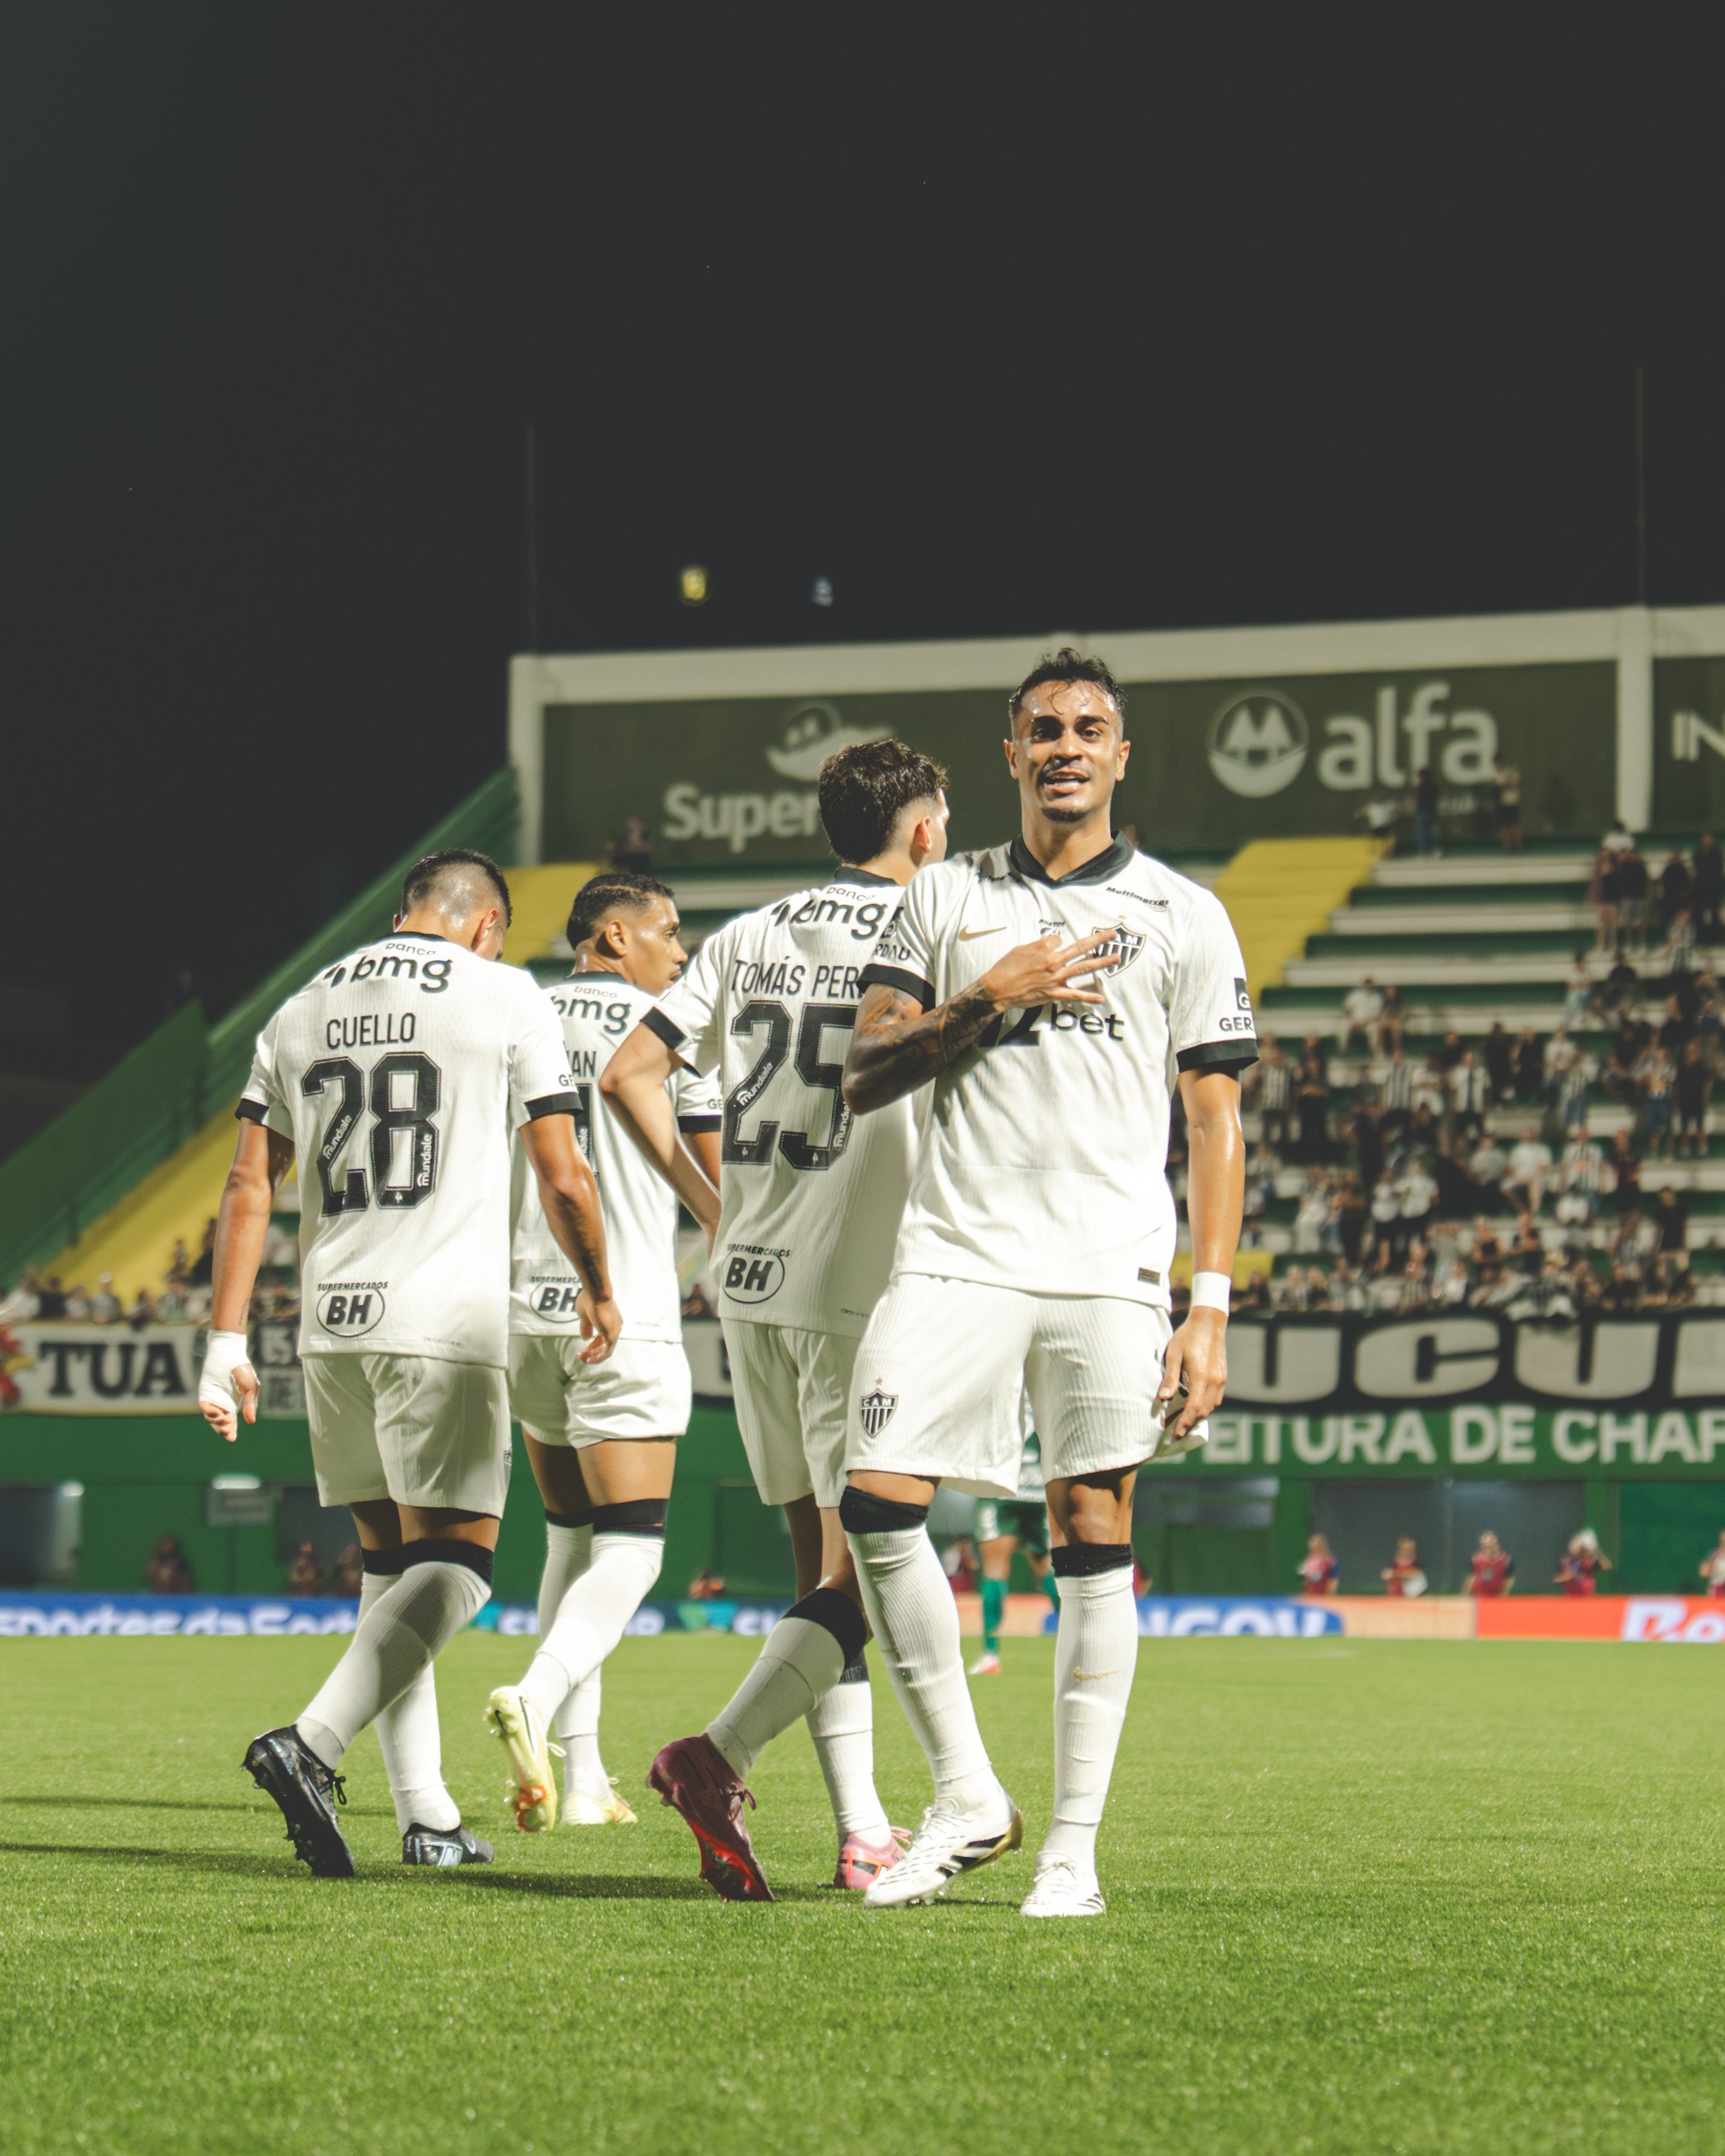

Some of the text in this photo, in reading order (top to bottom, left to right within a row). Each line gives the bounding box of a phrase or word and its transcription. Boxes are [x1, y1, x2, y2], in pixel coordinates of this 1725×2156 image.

[1317, 682, 1499, 791] alfa
[662, 783, 817, 854] Super
[789, 899, 888, 940] bmg
[385, 943, 436, 956] banco
[350, 955, 454, 994] bmg
[574, 985, 618, 998] banco
[731, 955, 863, 1000] TOMÁS PER
[327, 1012, 416, 1050] CUELLO
[1219, 1016, 1254, 1033] GER
[567, 1050, 597, 1078] AN
[736, 1061, 774, 1107] mundiale
[721, 1000, 858, 1171] 25
[301, 1051, 442, 1217] 28
[322, 1114, 353, 1161] mundiale
[416, 1133, 433, 1188] mundiale
[317, 1281, 389, 1291] SUPERMERCADOS
[725, 1256, 775, 1291] BH
[326, 1295, 374, 1326] BH
[538, 1287, 584, 1313] BH
[39, 1341, 187, 1398] TUA
[863, 1397, 892, 1407] CAM
[1149, 1409, 1437, 1465] EITURA
[1450, 1404, 1536, 1464] DE
